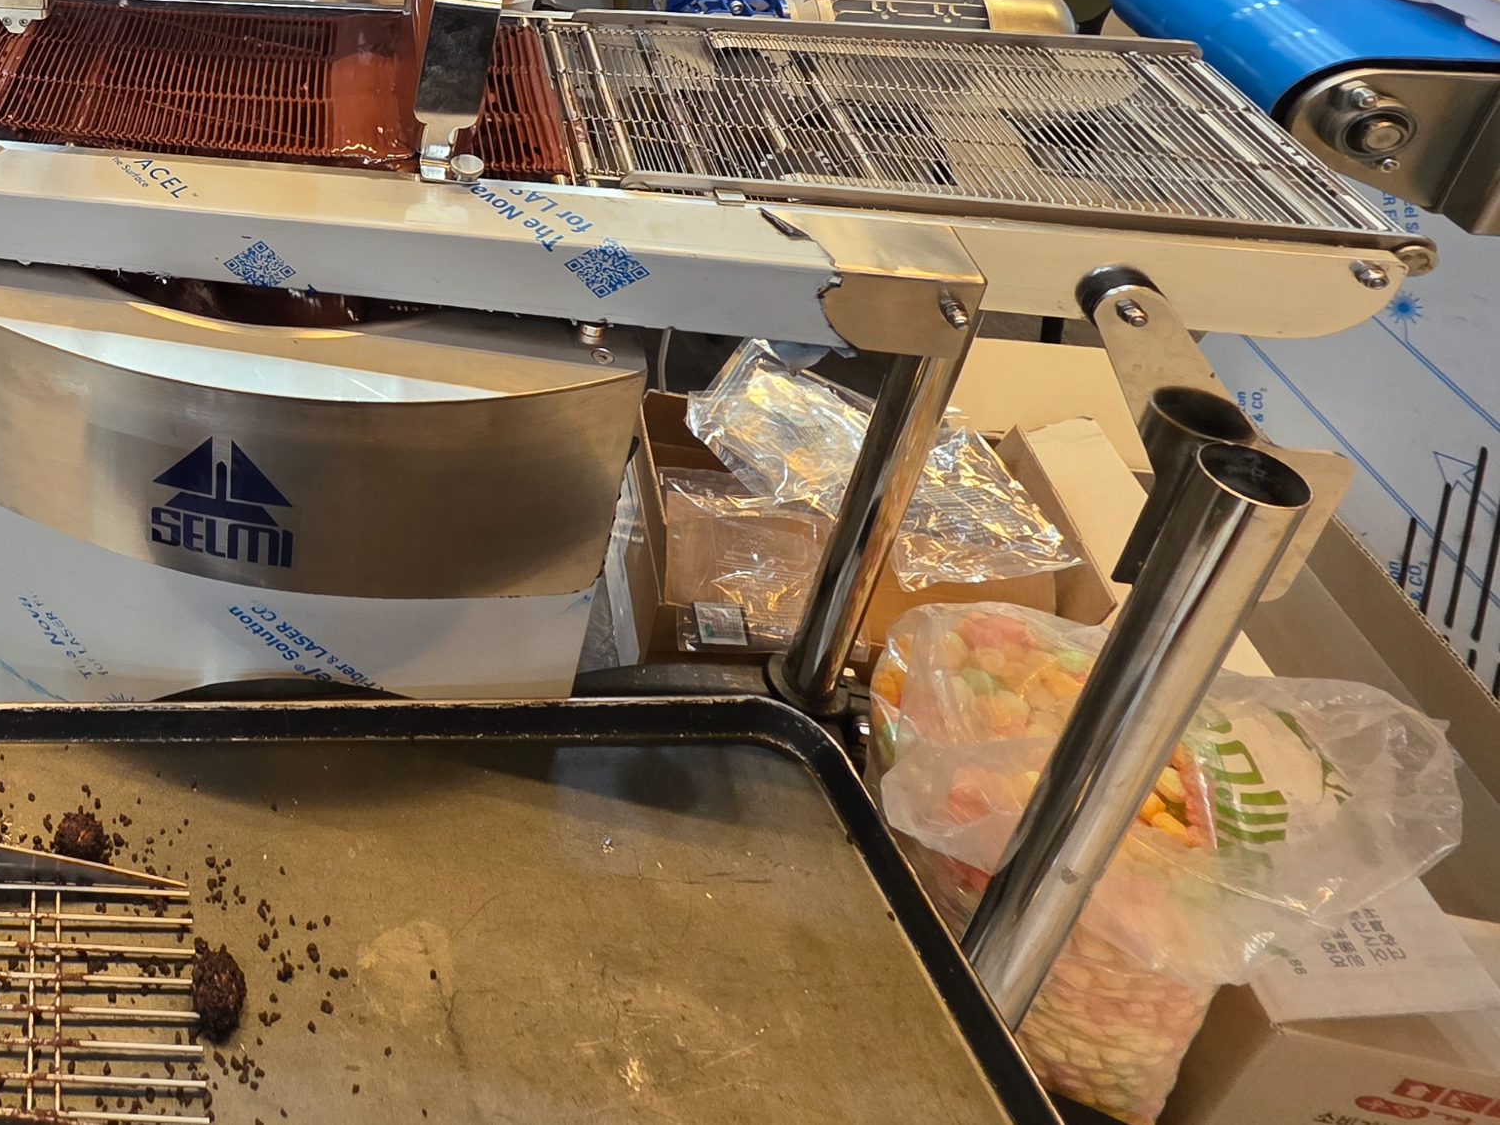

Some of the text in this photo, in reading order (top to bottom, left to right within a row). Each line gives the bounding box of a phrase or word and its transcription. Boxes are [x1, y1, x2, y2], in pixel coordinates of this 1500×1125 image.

[122, 164, 150, 188] Surface
[523, 217, 564, 252] The
[555, 210, 593, 233] for
[150, 506, 293, 568] SELMI
[227, 605, 300, 661] Solution
[277, 620, 328, 658] LASER
